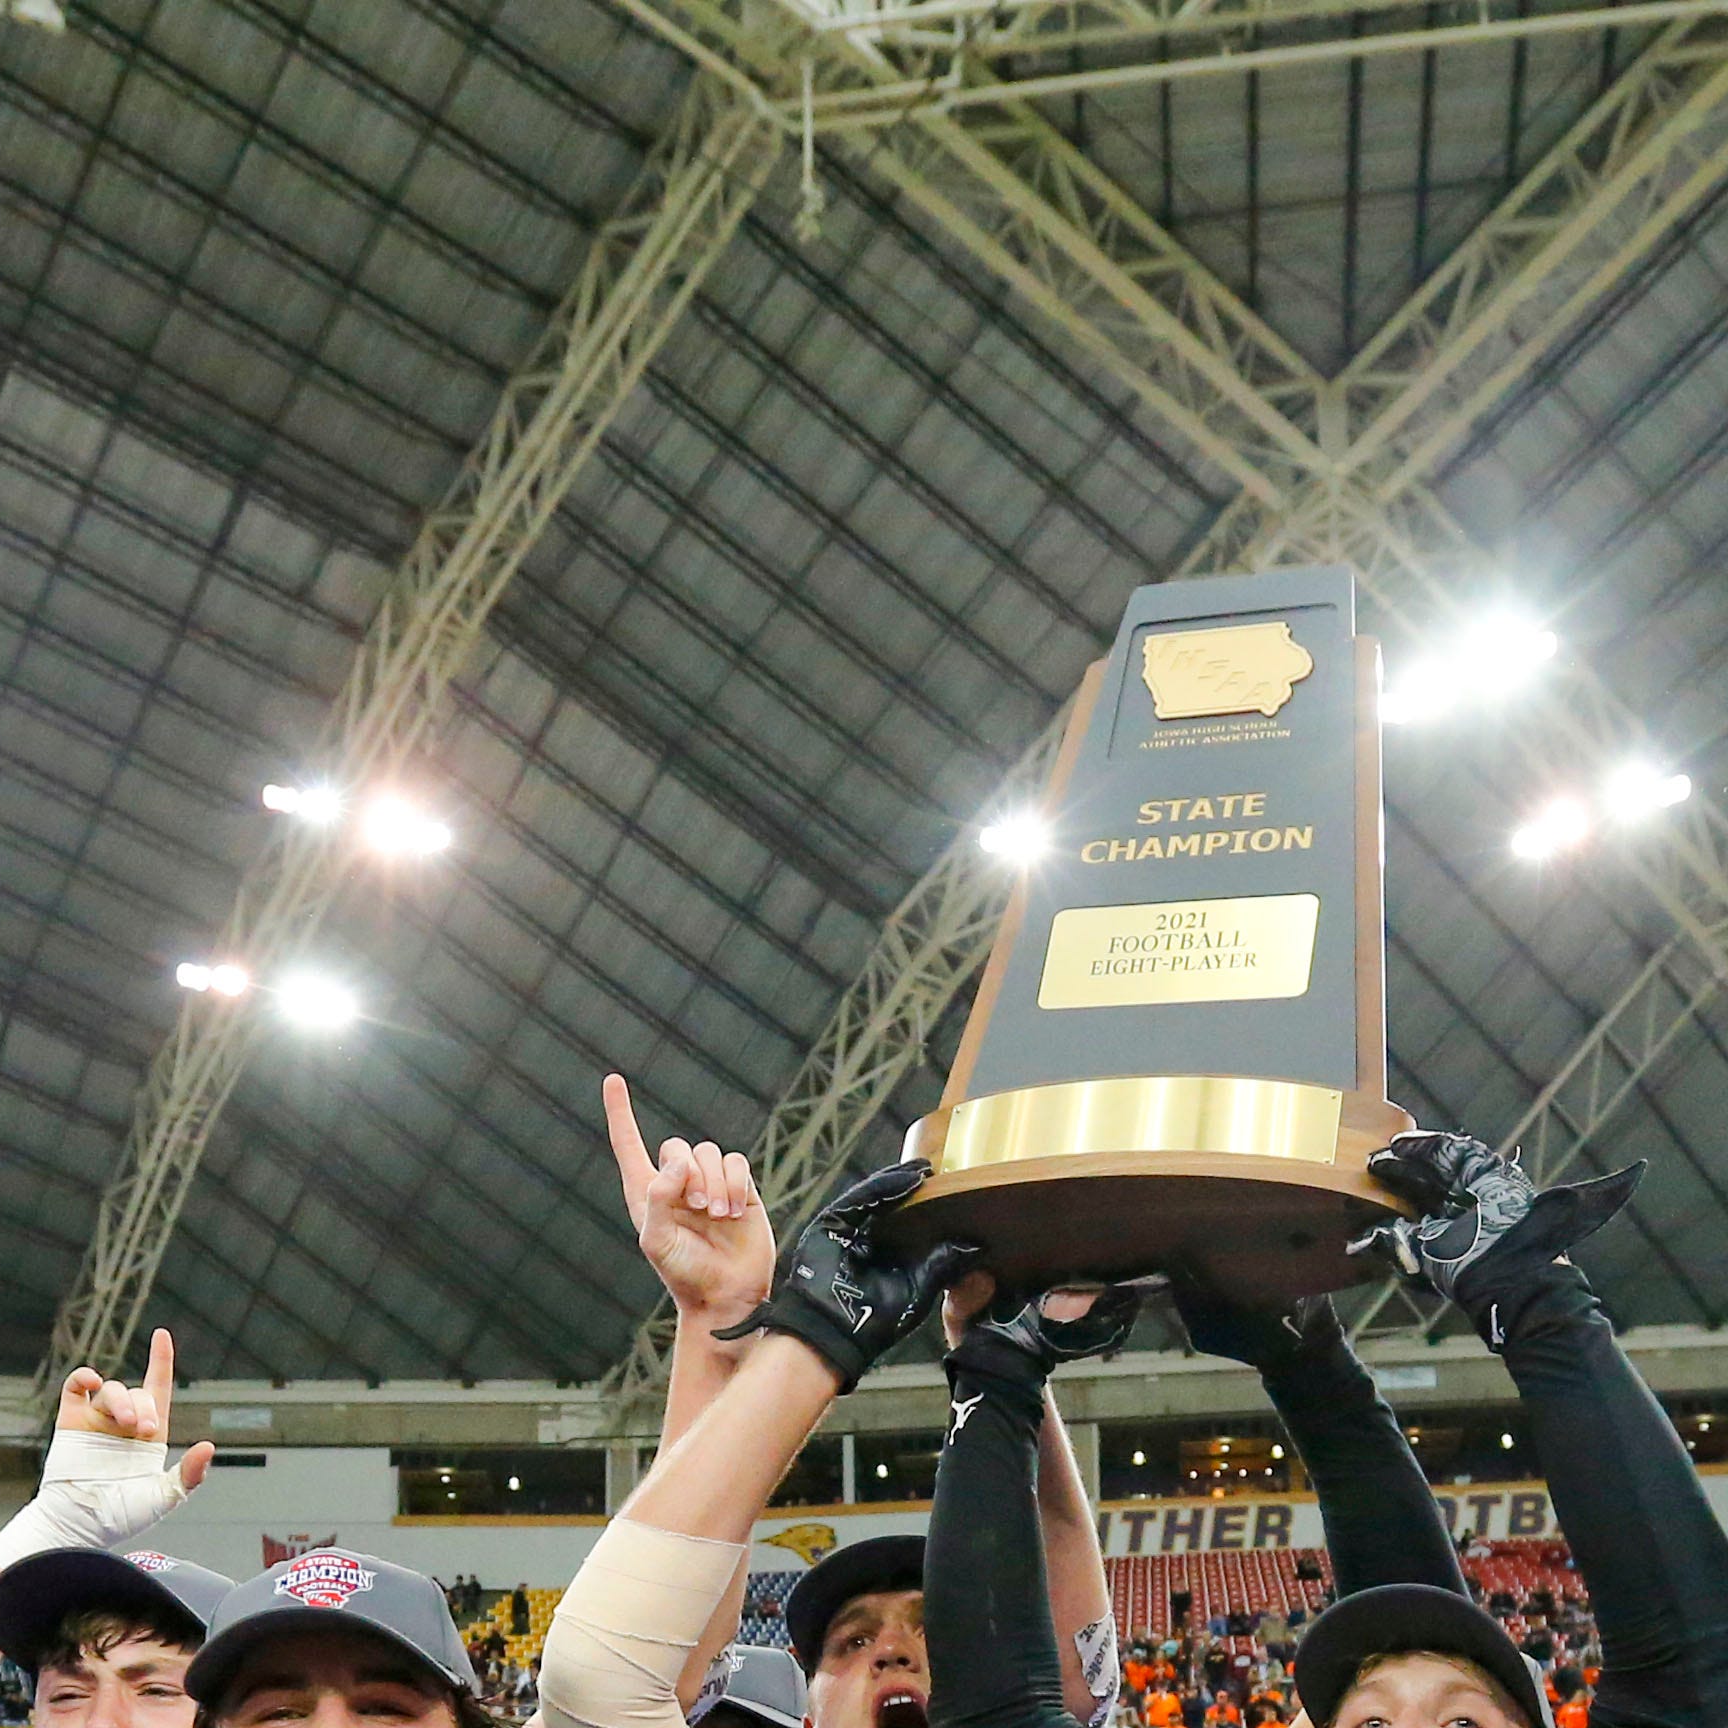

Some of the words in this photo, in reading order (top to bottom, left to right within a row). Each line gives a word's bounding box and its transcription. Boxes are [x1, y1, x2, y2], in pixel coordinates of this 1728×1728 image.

[1153, 728, 1189, 739] IOWA
[1201, 729, 1292, 745] ASSOCIATION
[1136, 792, 1267, 825] STATE
[1080, 825, 1314, 864] CHAMPION
[1155, 911, 1209, 931] 2021
[1107, 929, 1249, 954] FOOTBALL
[1089, 952, 1257, 976] EIGHT-PLAYER
[1100, 1502, 1294, 1555] THER
[305, 1556, 343, 1567] STATE
[275, 1565, 370, 1592] CHAMPION
